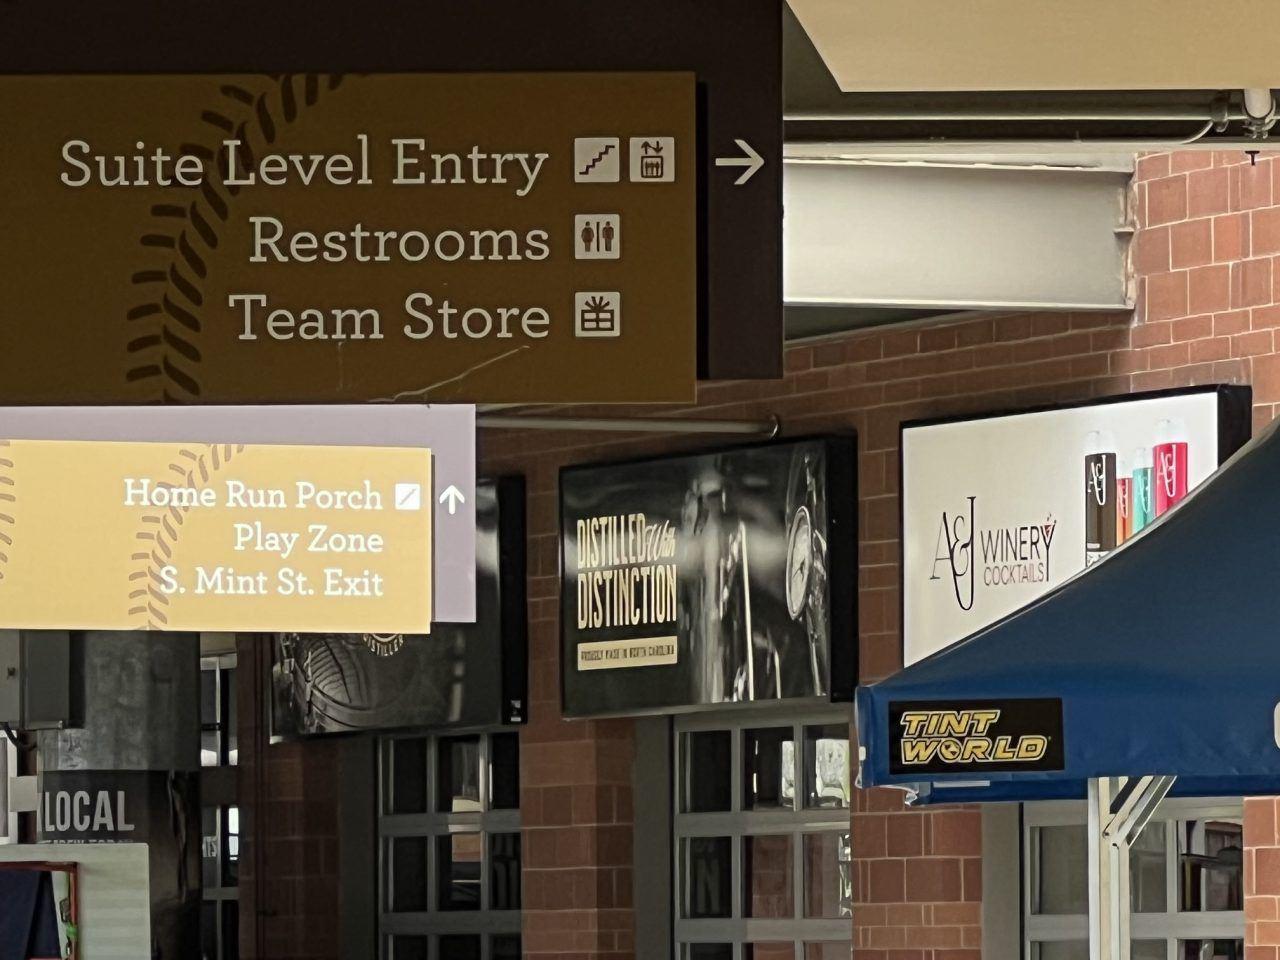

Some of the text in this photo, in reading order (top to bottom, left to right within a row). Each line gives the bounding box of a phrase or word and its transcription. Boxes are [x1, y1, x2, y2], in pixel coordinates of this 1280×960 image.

[61, 134, 549, 196] Suite Level Entry
[249, 216, 550, 262] Restrooms
[229, 292, 550, 340] Team Store
[124, 478, 384, 510] Home Run Porch
[233, 521, 384, 558] Play Zone
[576, 513, 646, 569] DISTILLED
[980, 520, 1057, 582] WINERY
[159, 566, 384, 596] S. Mint St. Exit
[983, 562, 1045, 587] COCKTAILS
[577, 564, 678, 630] DISTINCTION
[900, 710, 1001, 738] TINT
[44, 790, 135, 832] LOCAL
